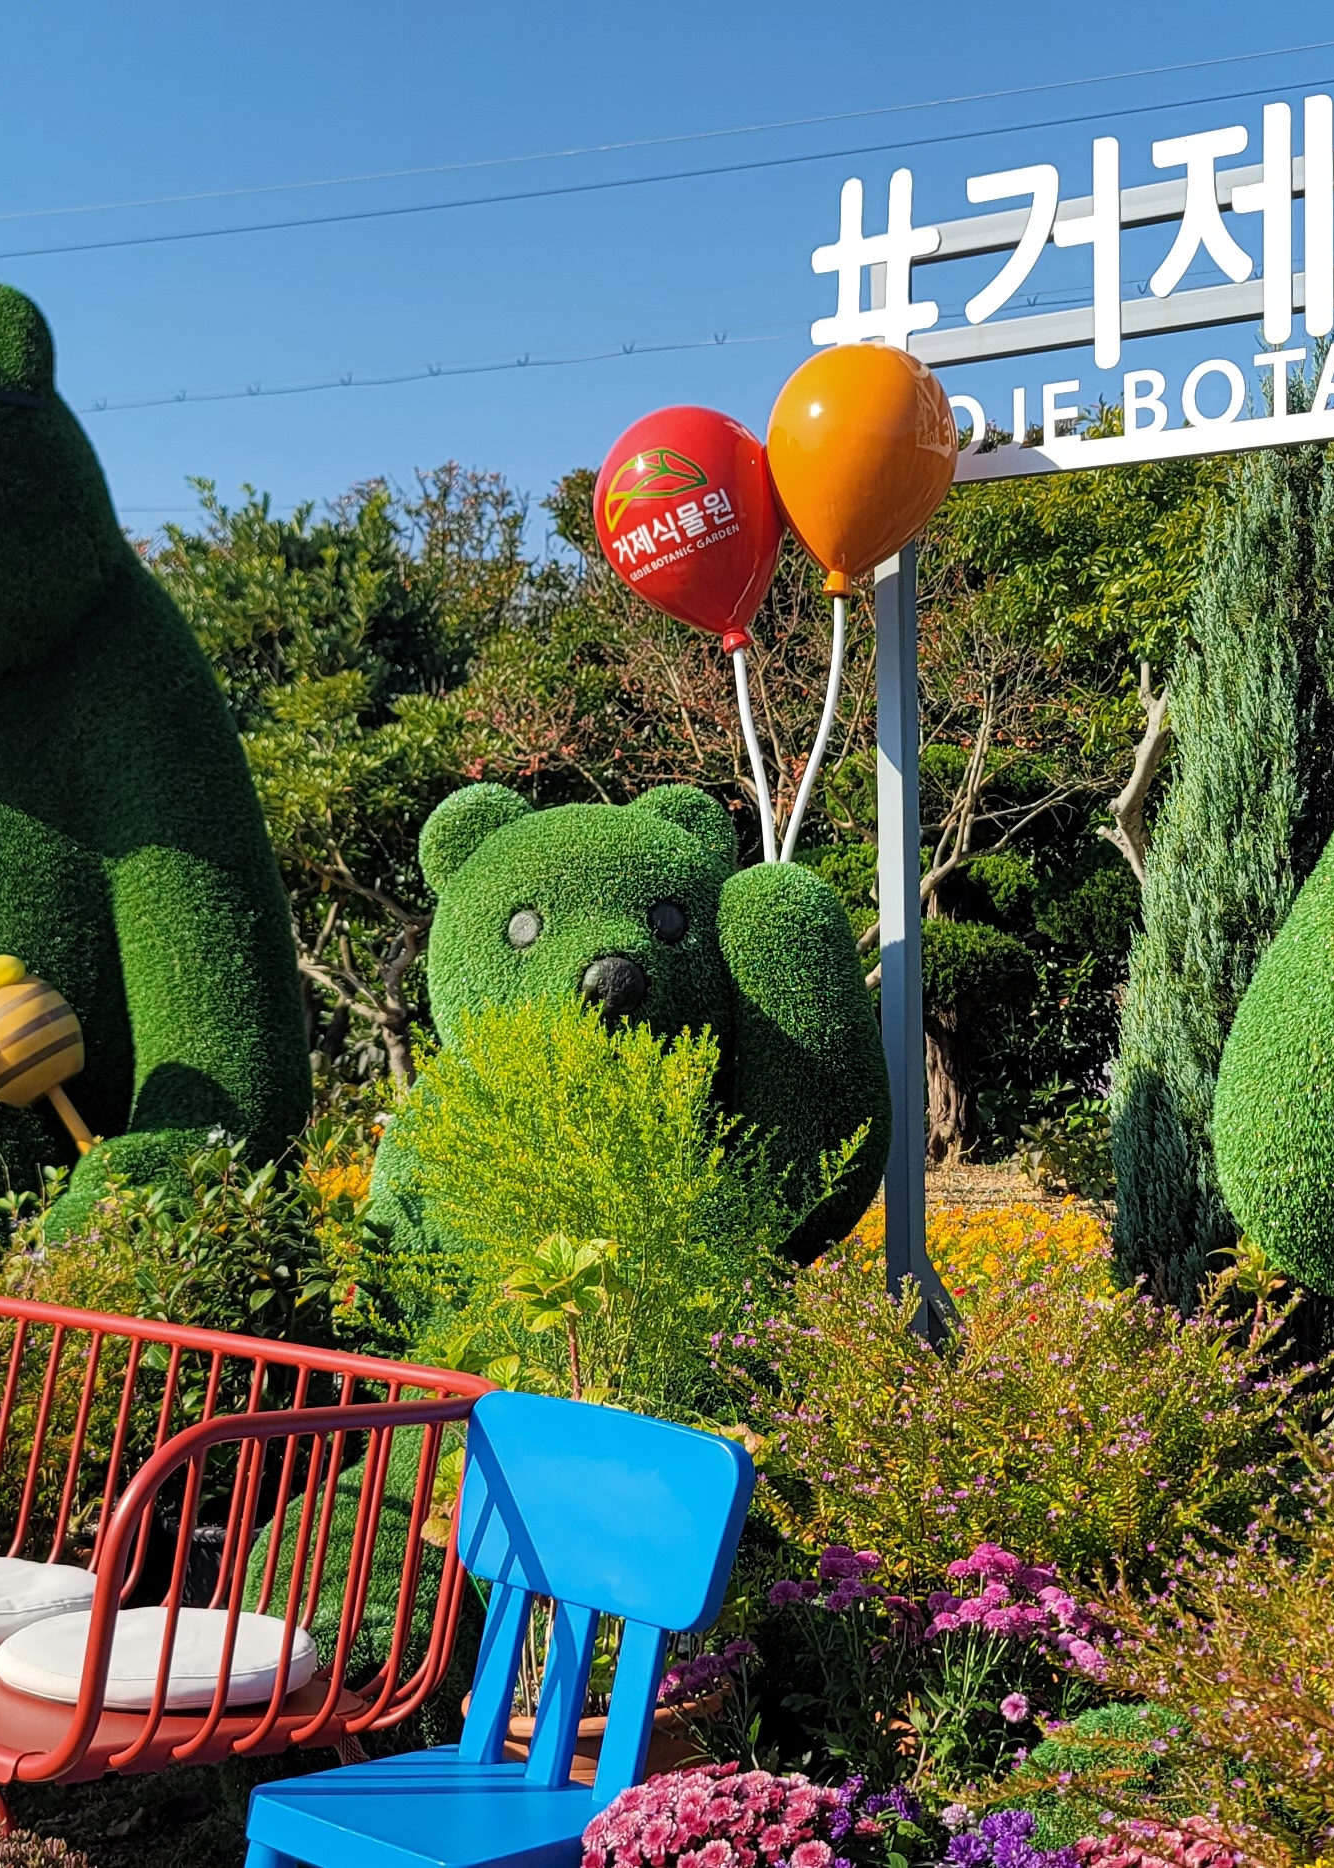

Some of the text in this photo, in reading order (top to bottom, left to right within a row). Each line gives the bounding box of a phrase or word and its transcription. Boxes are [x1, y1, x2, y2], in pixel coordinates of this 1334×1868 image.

[948, 379, 1081, 454] OJE
[612, 488, 735, 565] 거제식물원
[629, 523, 740, 582] GEOJE BOTANIC GARDEN
